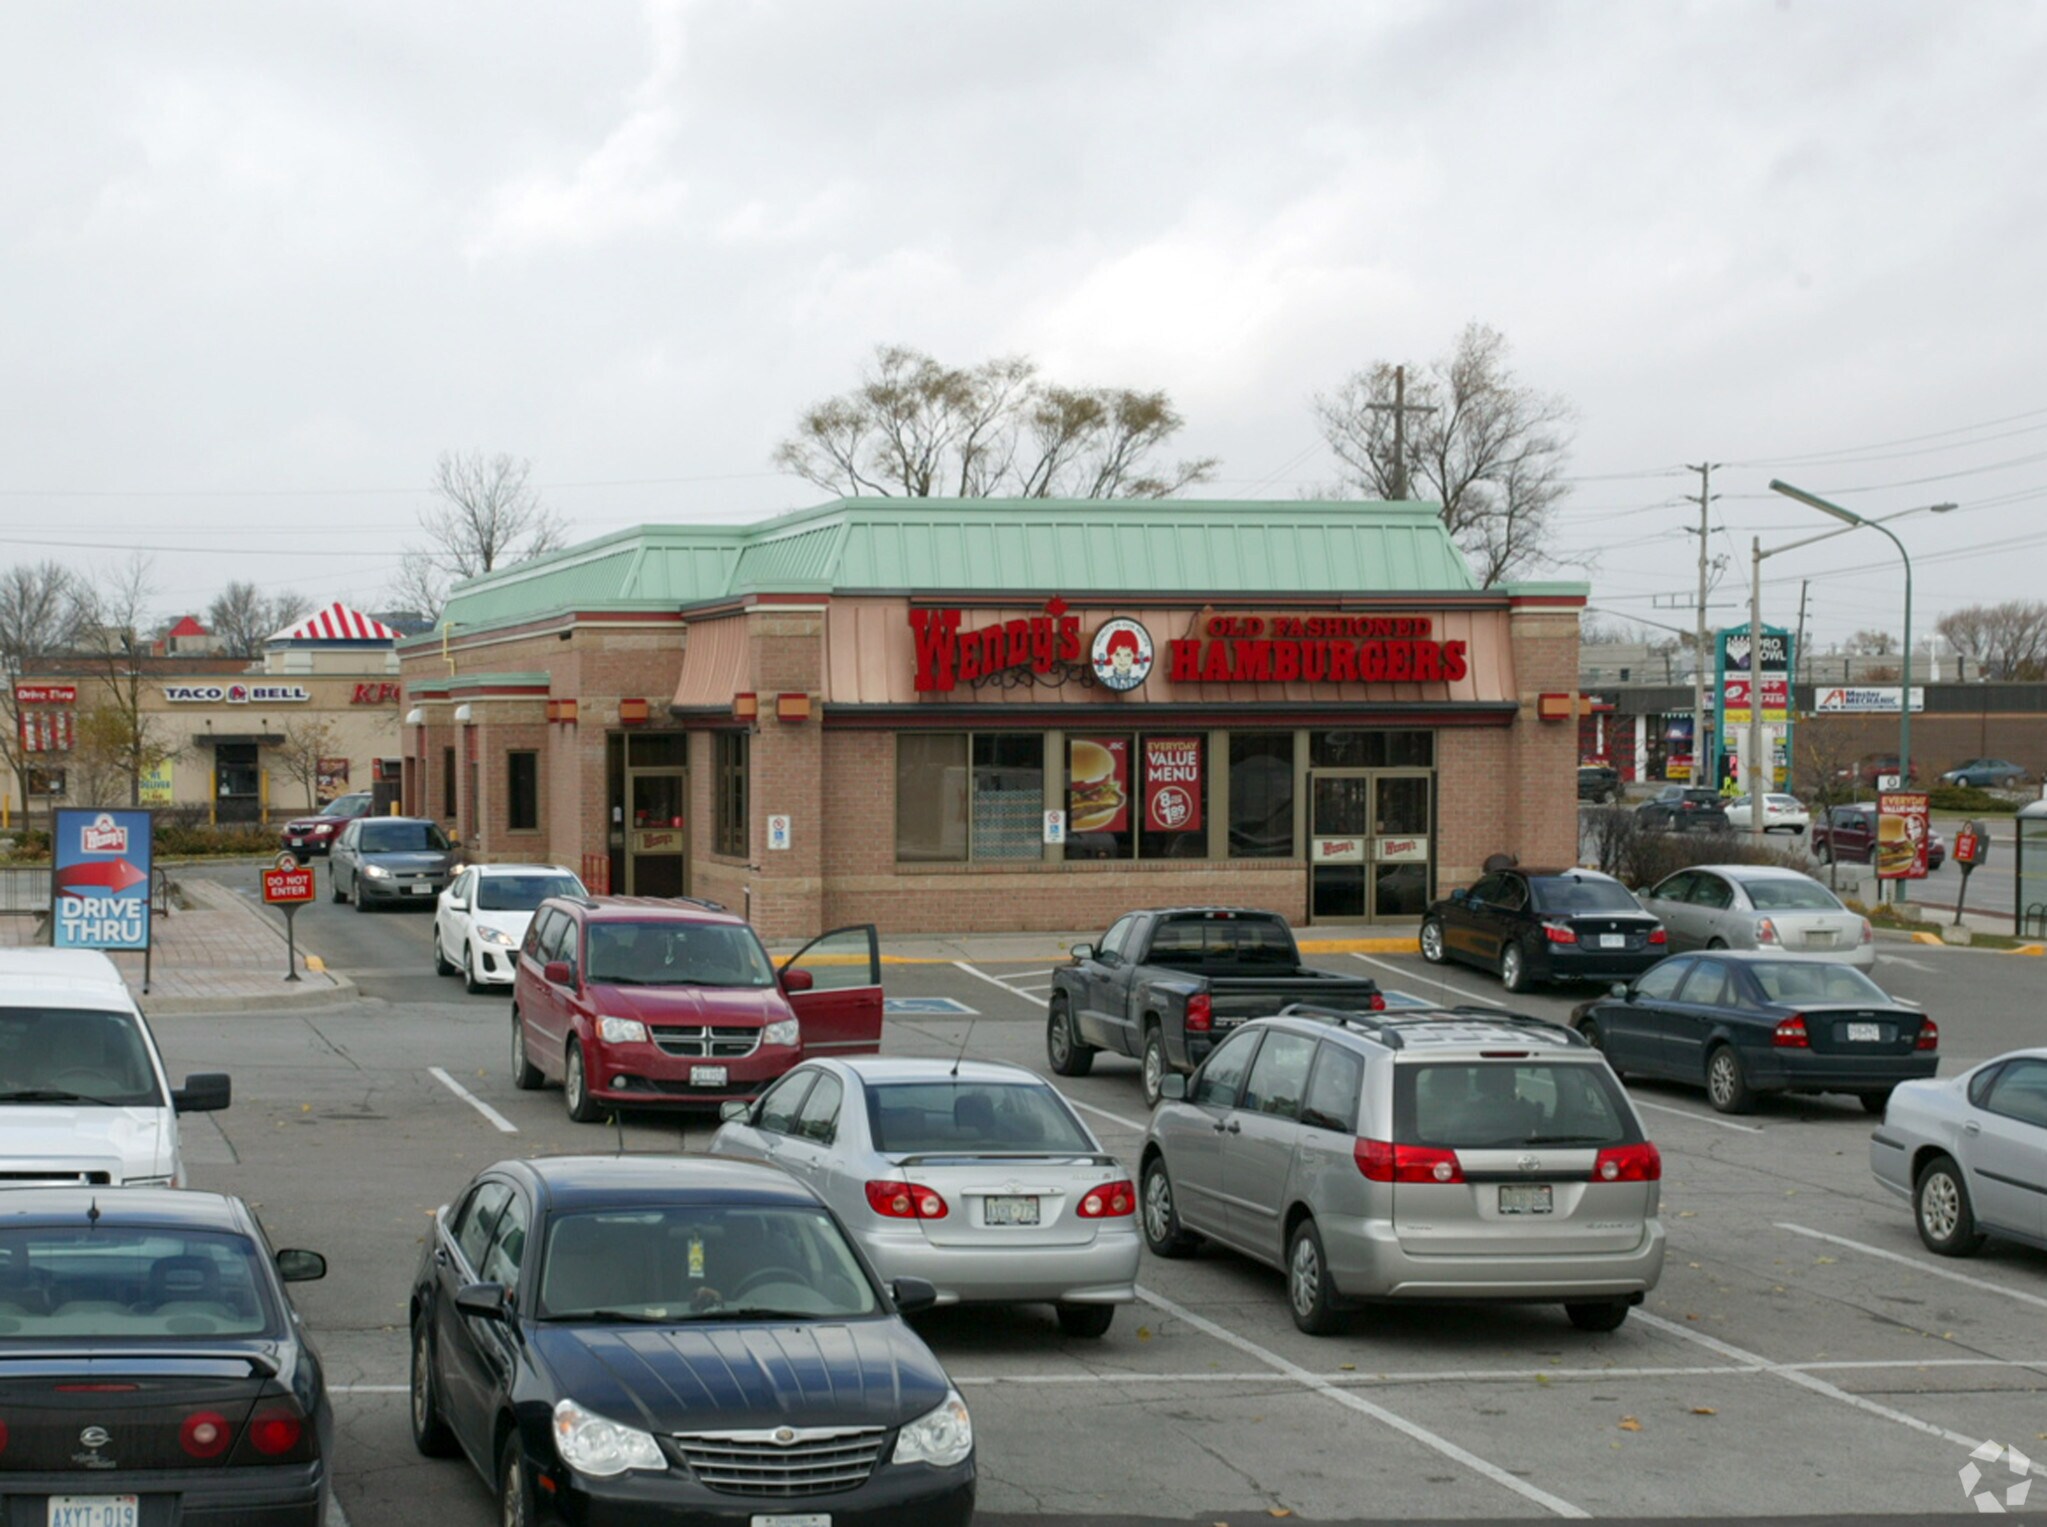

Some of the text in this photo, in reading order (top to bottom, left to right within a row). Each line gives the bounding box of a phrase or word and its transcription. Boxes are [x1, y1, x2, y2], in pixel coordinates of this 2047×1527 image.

[1208, 616, 1432, 637] OLD FASHIONED
[1169, 639, 1467, 682] HAMBURGERS
[1760, 650, 1787, 661] OWL
[166, 686, 308, 699] TACO BELL
[1147, 742, 1198, 751] EVERYDAY
[1148, 751, 1197, 766] VALUE
[1149, 767, 1198, 782] MENU
[267, 875, 308, 887] DO NOT
[271, 886, 307, 897] ENTER
[62, 896, 142, 919] DRIVE
[61, 919, 142, 942] THRU
